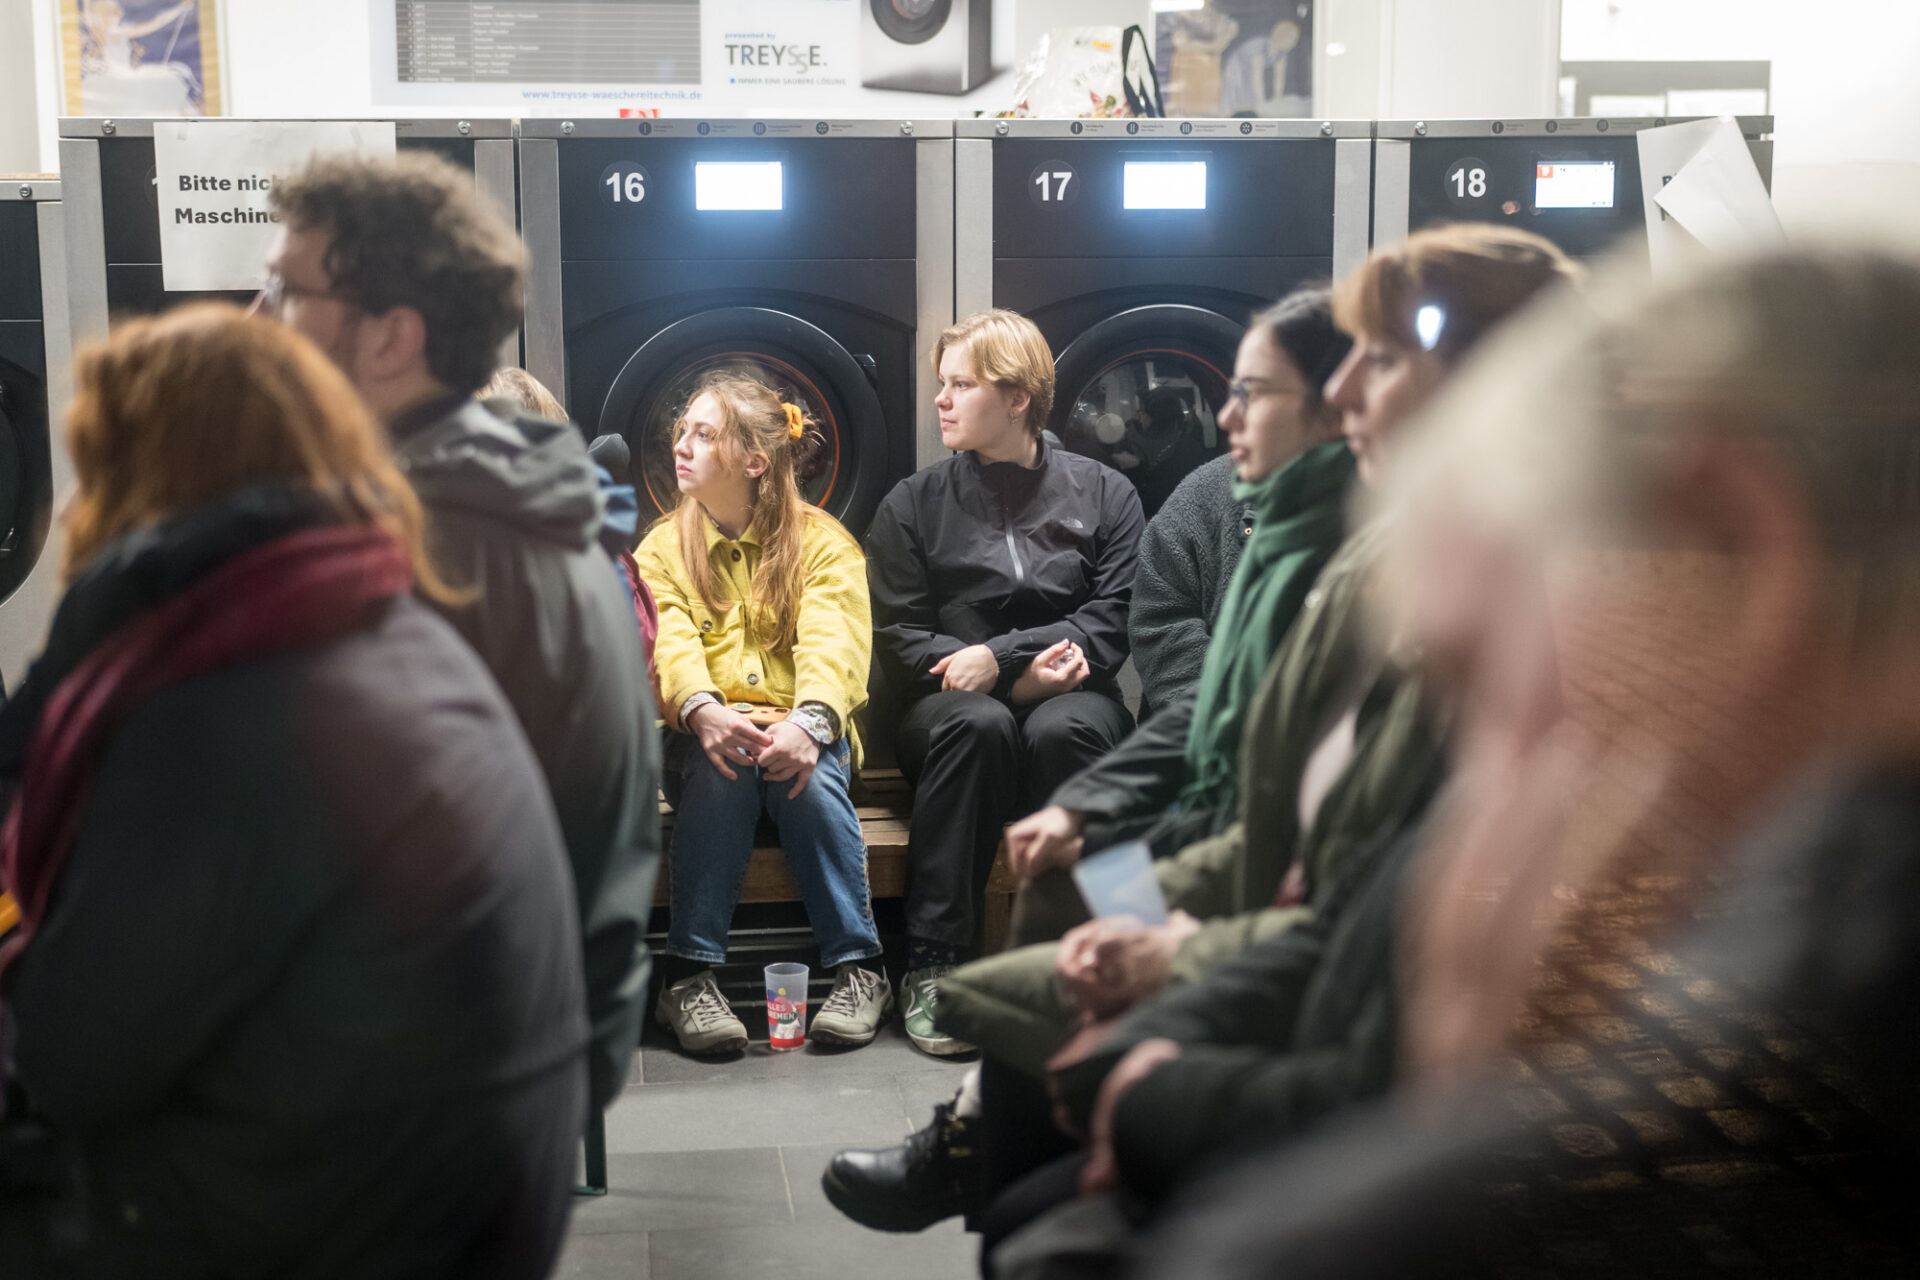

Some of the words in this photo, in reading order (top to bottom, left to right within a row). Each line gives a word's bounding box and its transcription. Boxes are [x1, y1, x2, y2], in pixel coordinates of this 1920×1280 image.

[766, 32, 776, 40] by
[178, 174, 232, 191] Bitte
[237, 174, 275, 191] nic
[606, 172, 645, 202] 16
[1035, 171, 1073, 201] 17
[1451, 168, 1486, 198] 18
